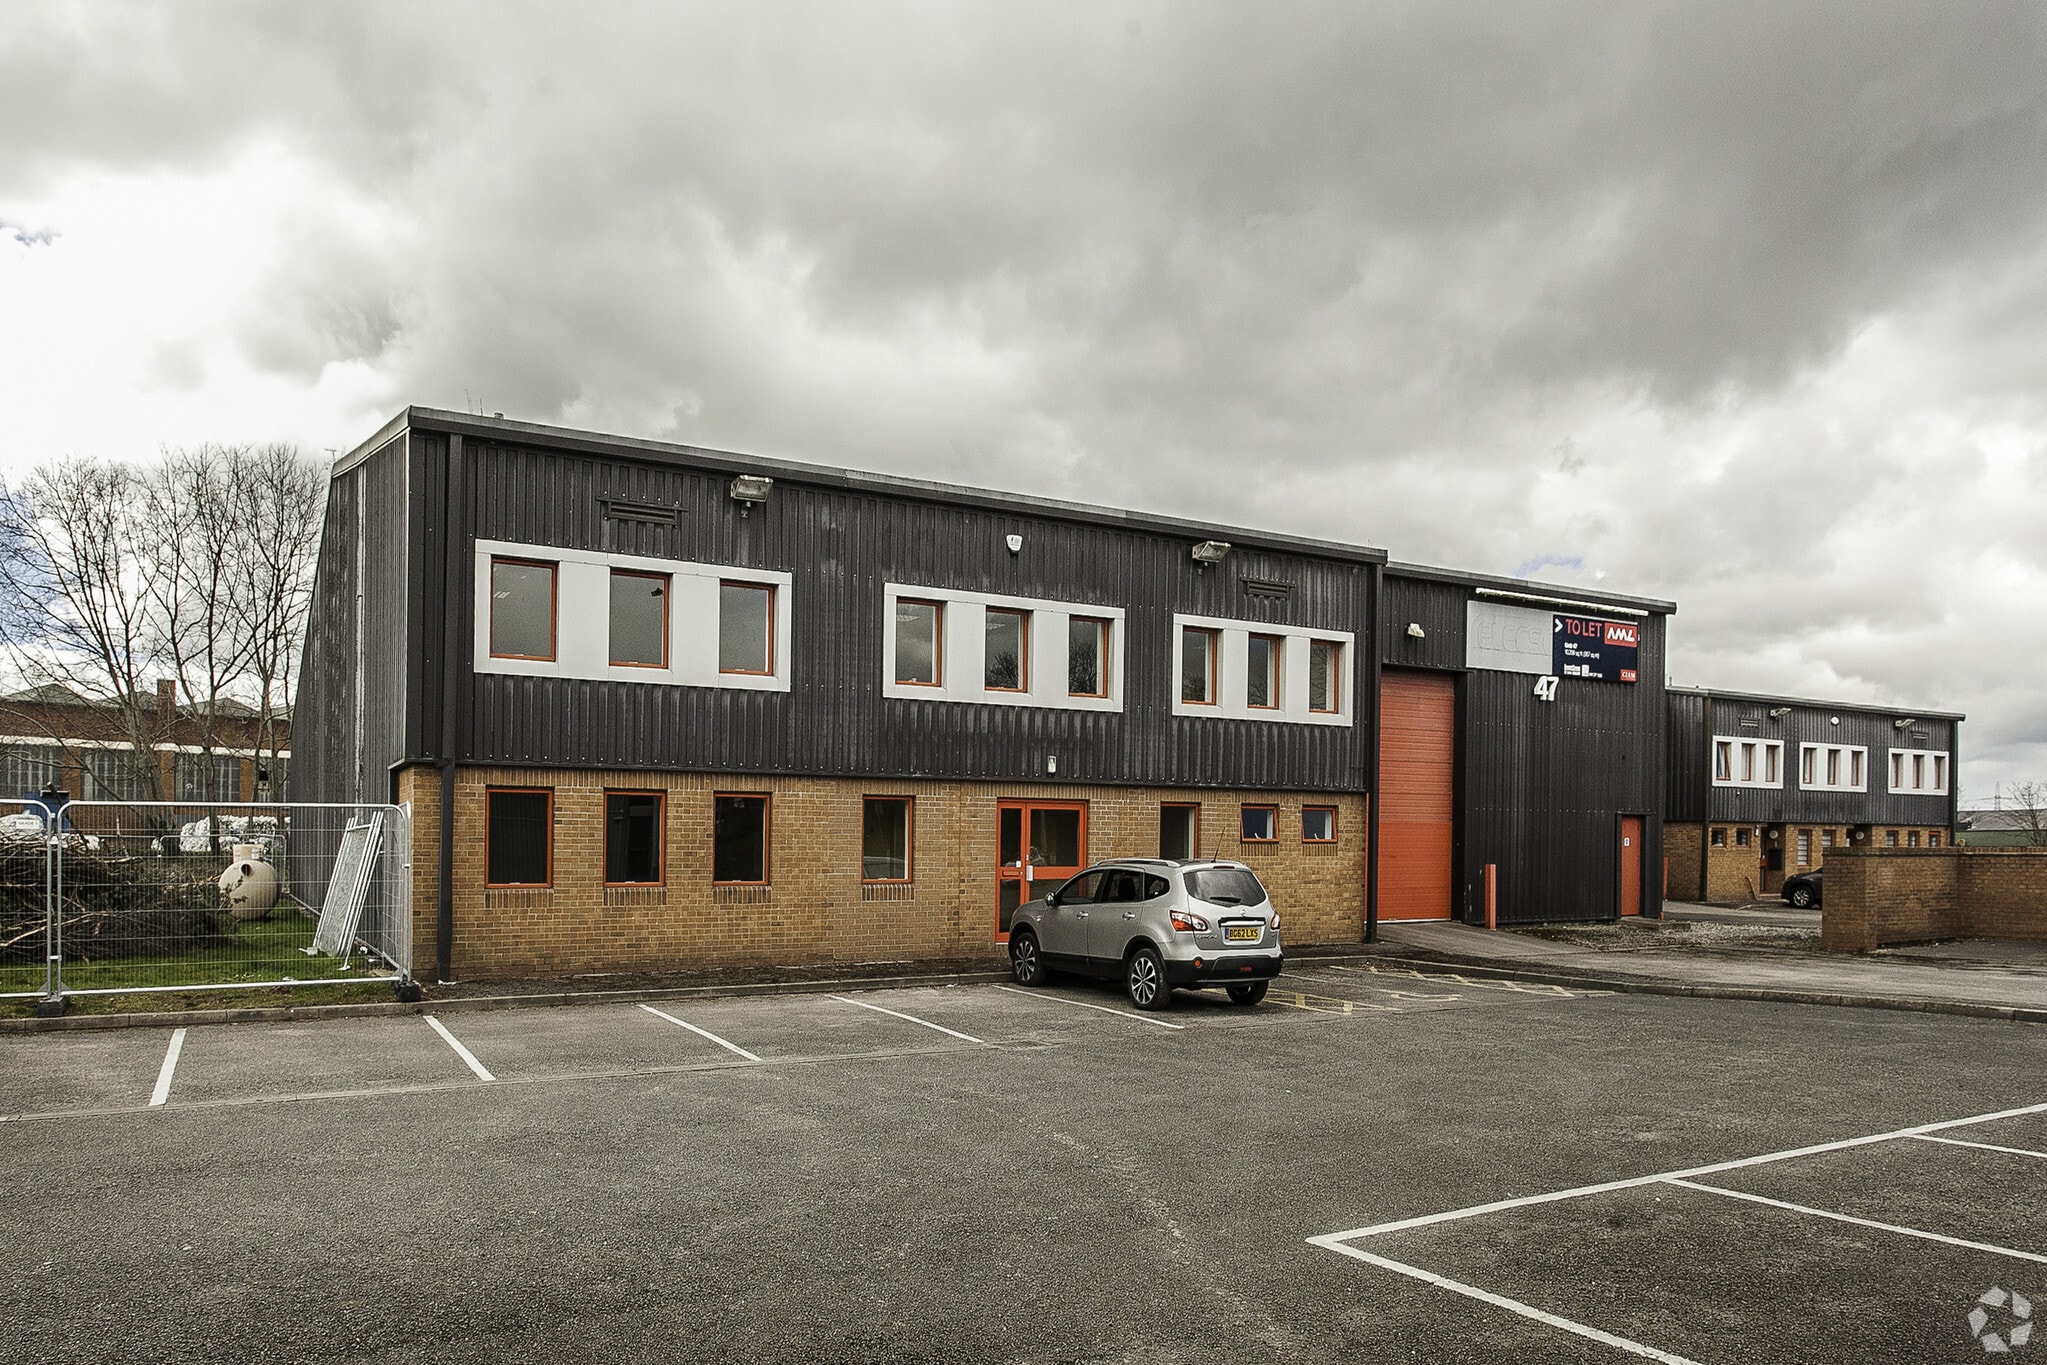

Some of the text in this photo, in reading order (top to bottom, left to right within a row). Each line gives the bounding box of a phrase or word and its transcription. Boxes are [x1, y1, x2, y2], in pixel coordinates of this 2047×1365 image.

[1565, 619, 1602, 637] TO LET
[1533, 675, 1559, 701] 47
